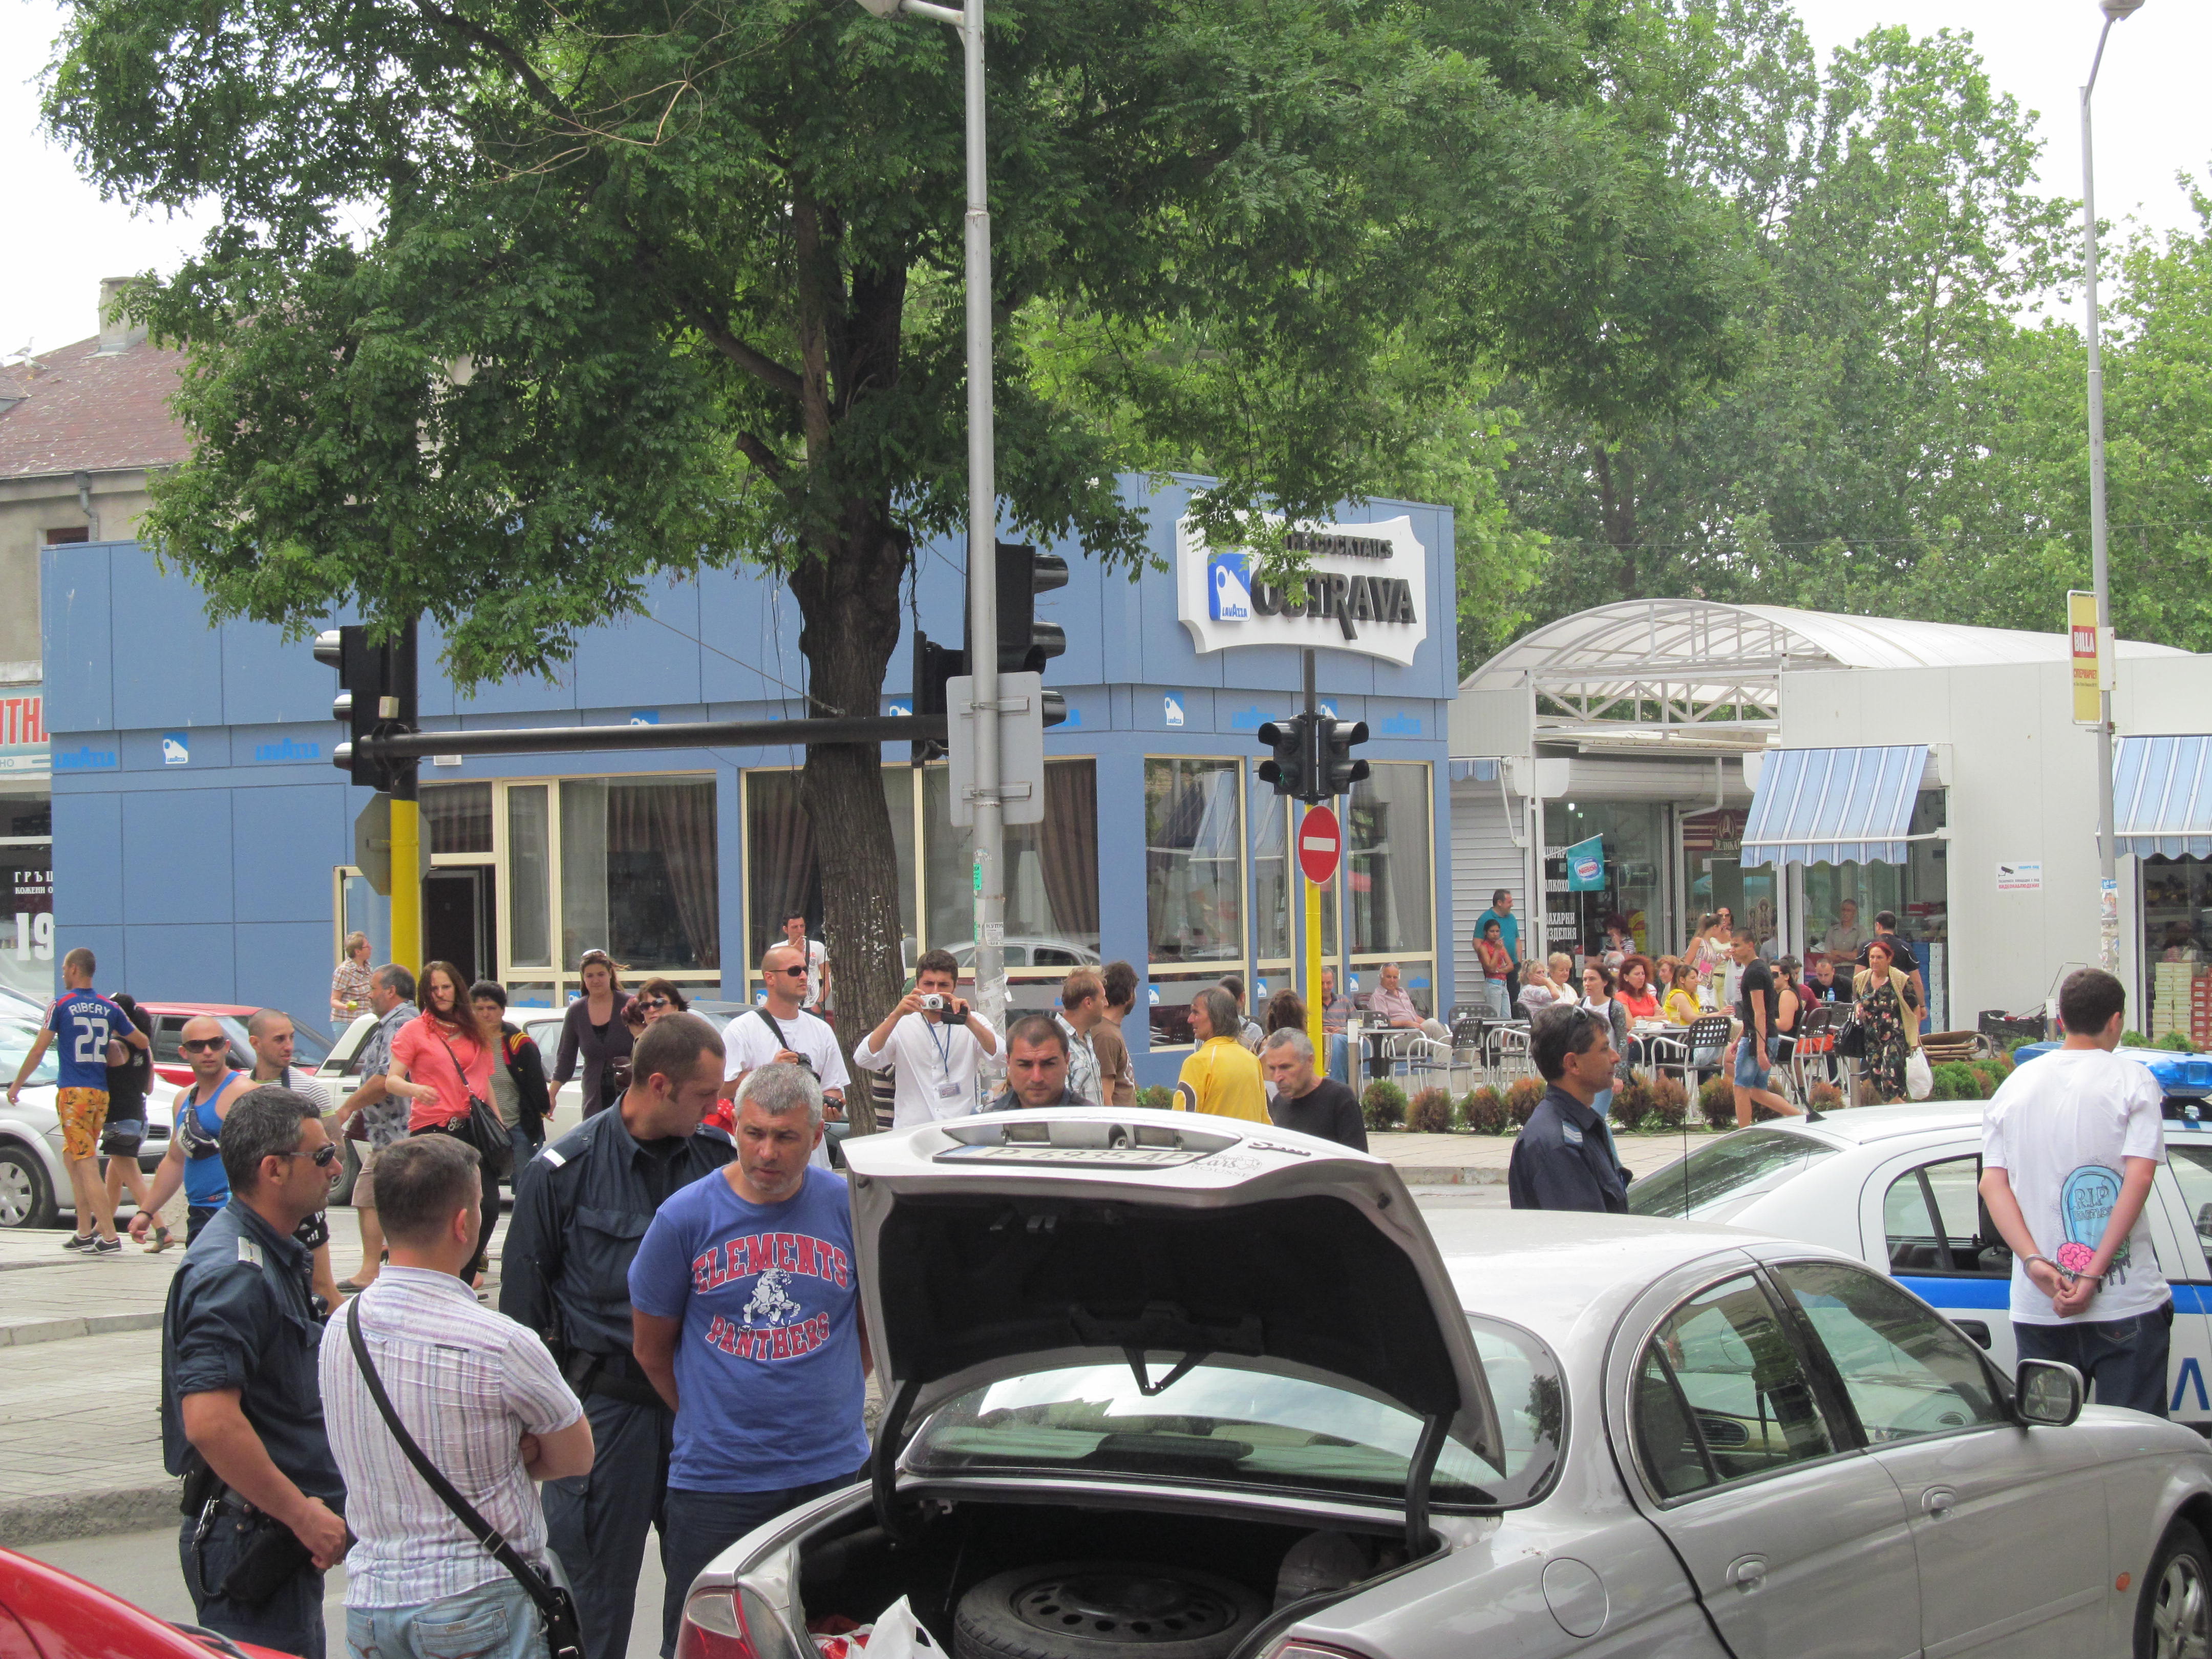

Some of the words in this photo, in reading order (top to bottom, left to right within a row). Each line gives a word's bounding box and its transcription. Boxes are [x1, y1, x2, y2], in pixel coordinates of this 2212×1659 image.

[1314, 533, 1394, 559] COCKTAILS
[1222, 603, 1248, 618] LAVAZZA
[2074, 631, 2095, 653] BILLA
[1544, 846, 1568, 861] ЦИГАР
[68, 1002, 111, 1016] RIBERY
[73, 1016, 110, 1063] 22
[1031, 1150, 1136, 1160] 6935
[1189, 1164, 1251, 1178] ROUSSE
[692, 1232, 848, 1295] ELEMENTS
[705, 1312, 830, 1360] PANTHERS
